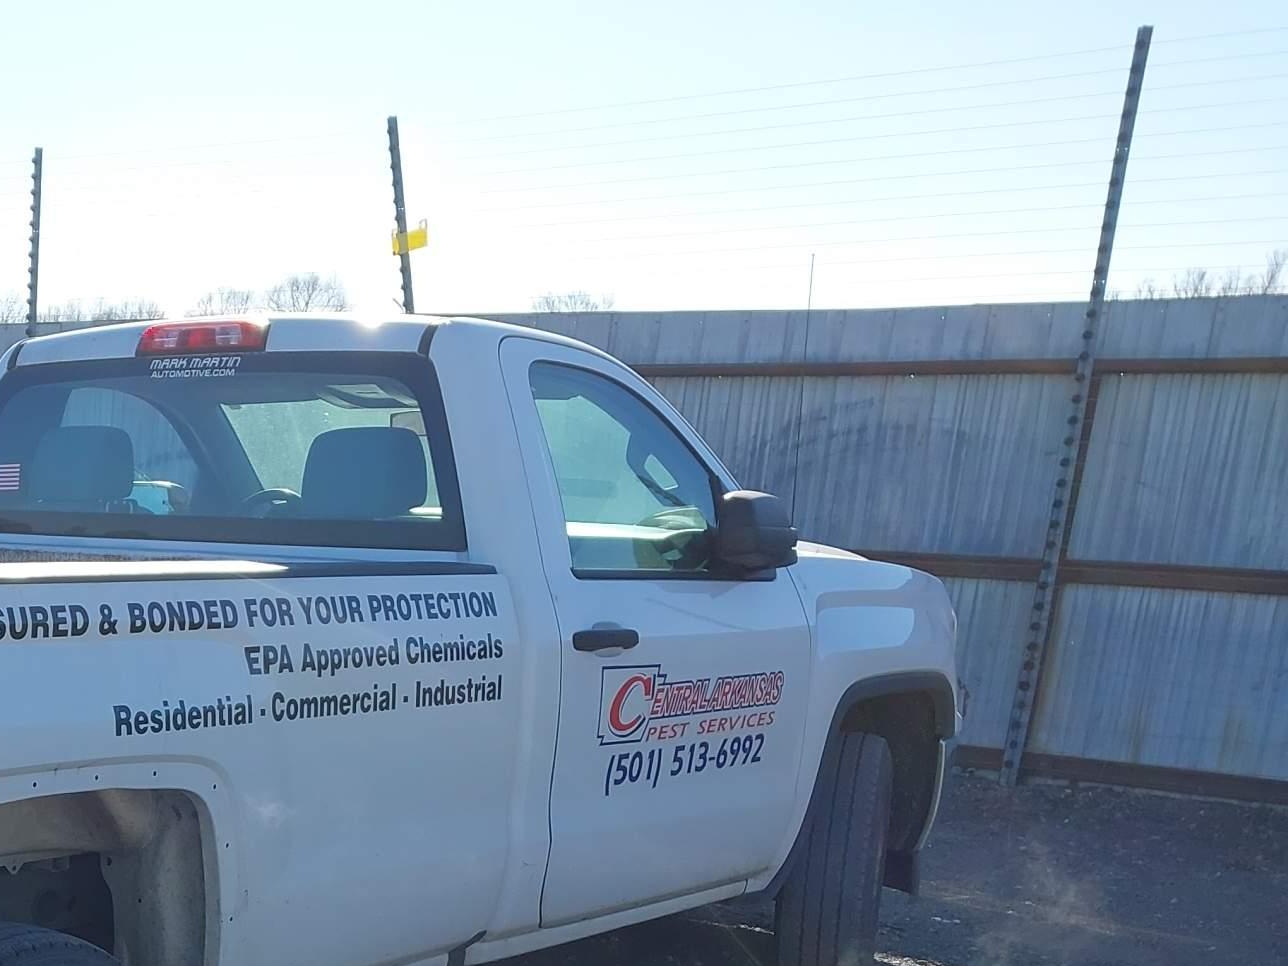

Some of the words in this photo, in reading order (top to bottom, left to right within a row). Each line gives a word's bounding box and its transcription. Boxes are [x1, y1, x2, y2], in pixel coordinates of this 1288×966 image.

[150, 357, 188, 369] MARK
[150, 368, 235, 378] AUTOMOTIVE.COM
[98, 603, 118, 636] &
[127, 600, 239, 634] BONDED
[244, 597, 295, 628] FOR
[297, 595, 364, 625] YOUR
[367, 591, 498, 622] PROTECTION
[244, 644, 294, 675] EPA
[301, 638, 400, 678] Approved
[405, 633, 504, 665] Chemicals
[113, 694, 253, 737] Residential
[271, 683, 397, 722] Commercial
[415, 674, 503, 708] Industrial
[645, 722, 690, 742] PEST
[697, 711, 775, 735] SERVICES
[604, 748, 663, 796] (501)
[670, 733, 765, 776] 513-6992
